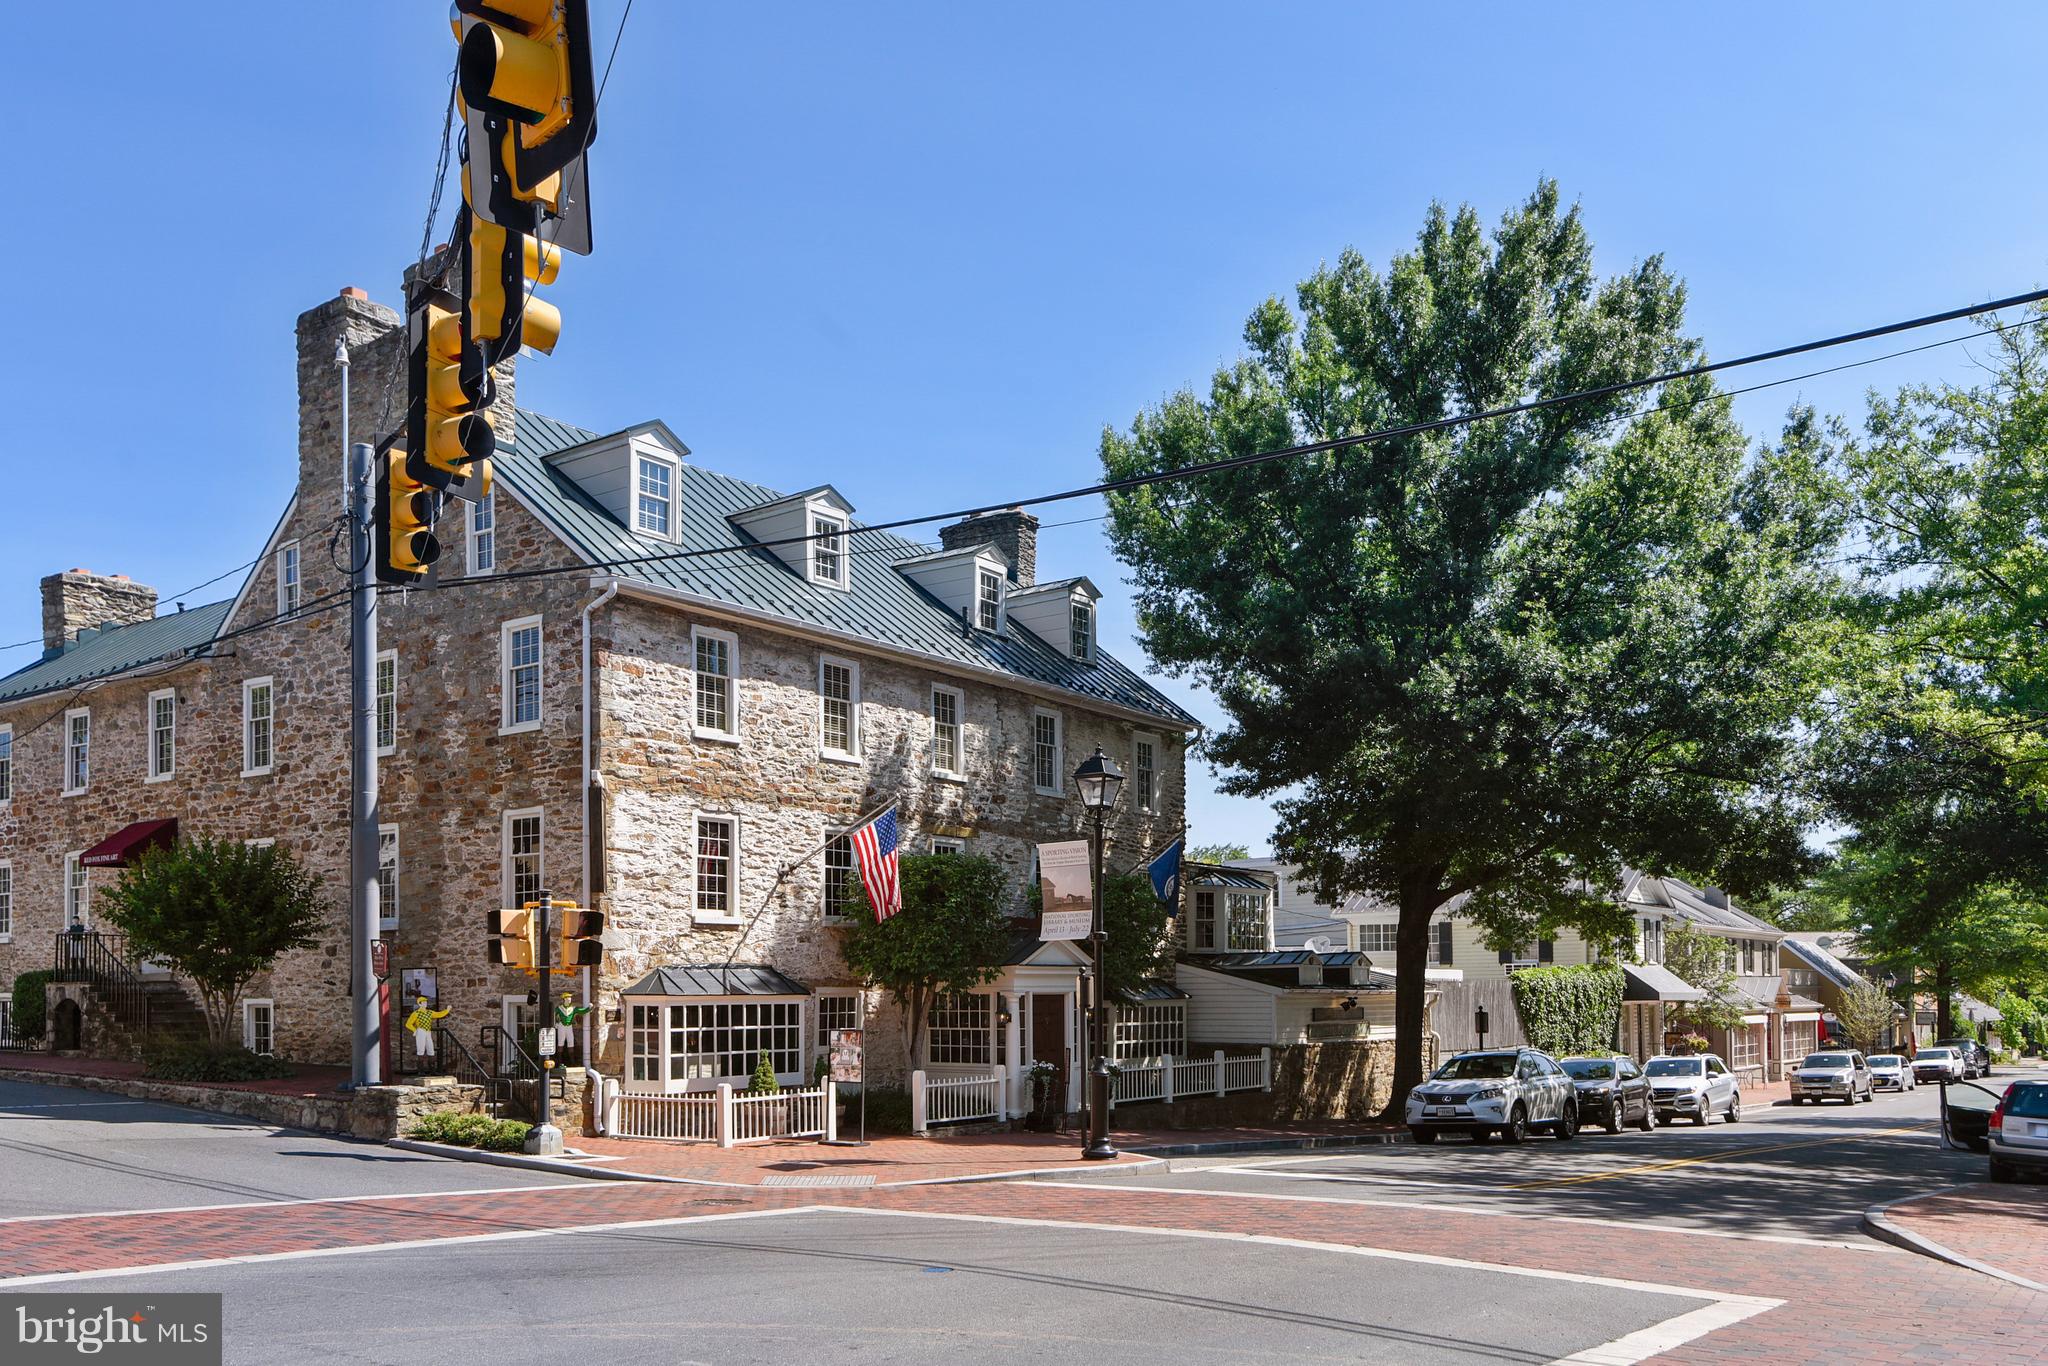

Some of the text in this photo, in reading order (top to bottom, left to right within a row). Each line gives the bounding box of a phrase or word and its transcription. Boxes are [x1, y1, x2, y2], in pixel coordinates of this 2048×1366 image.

[1044, 926, 1058, 935] April
[1069, 925, 1081, 935] July
[1081, 924, 1089, 932] 22
